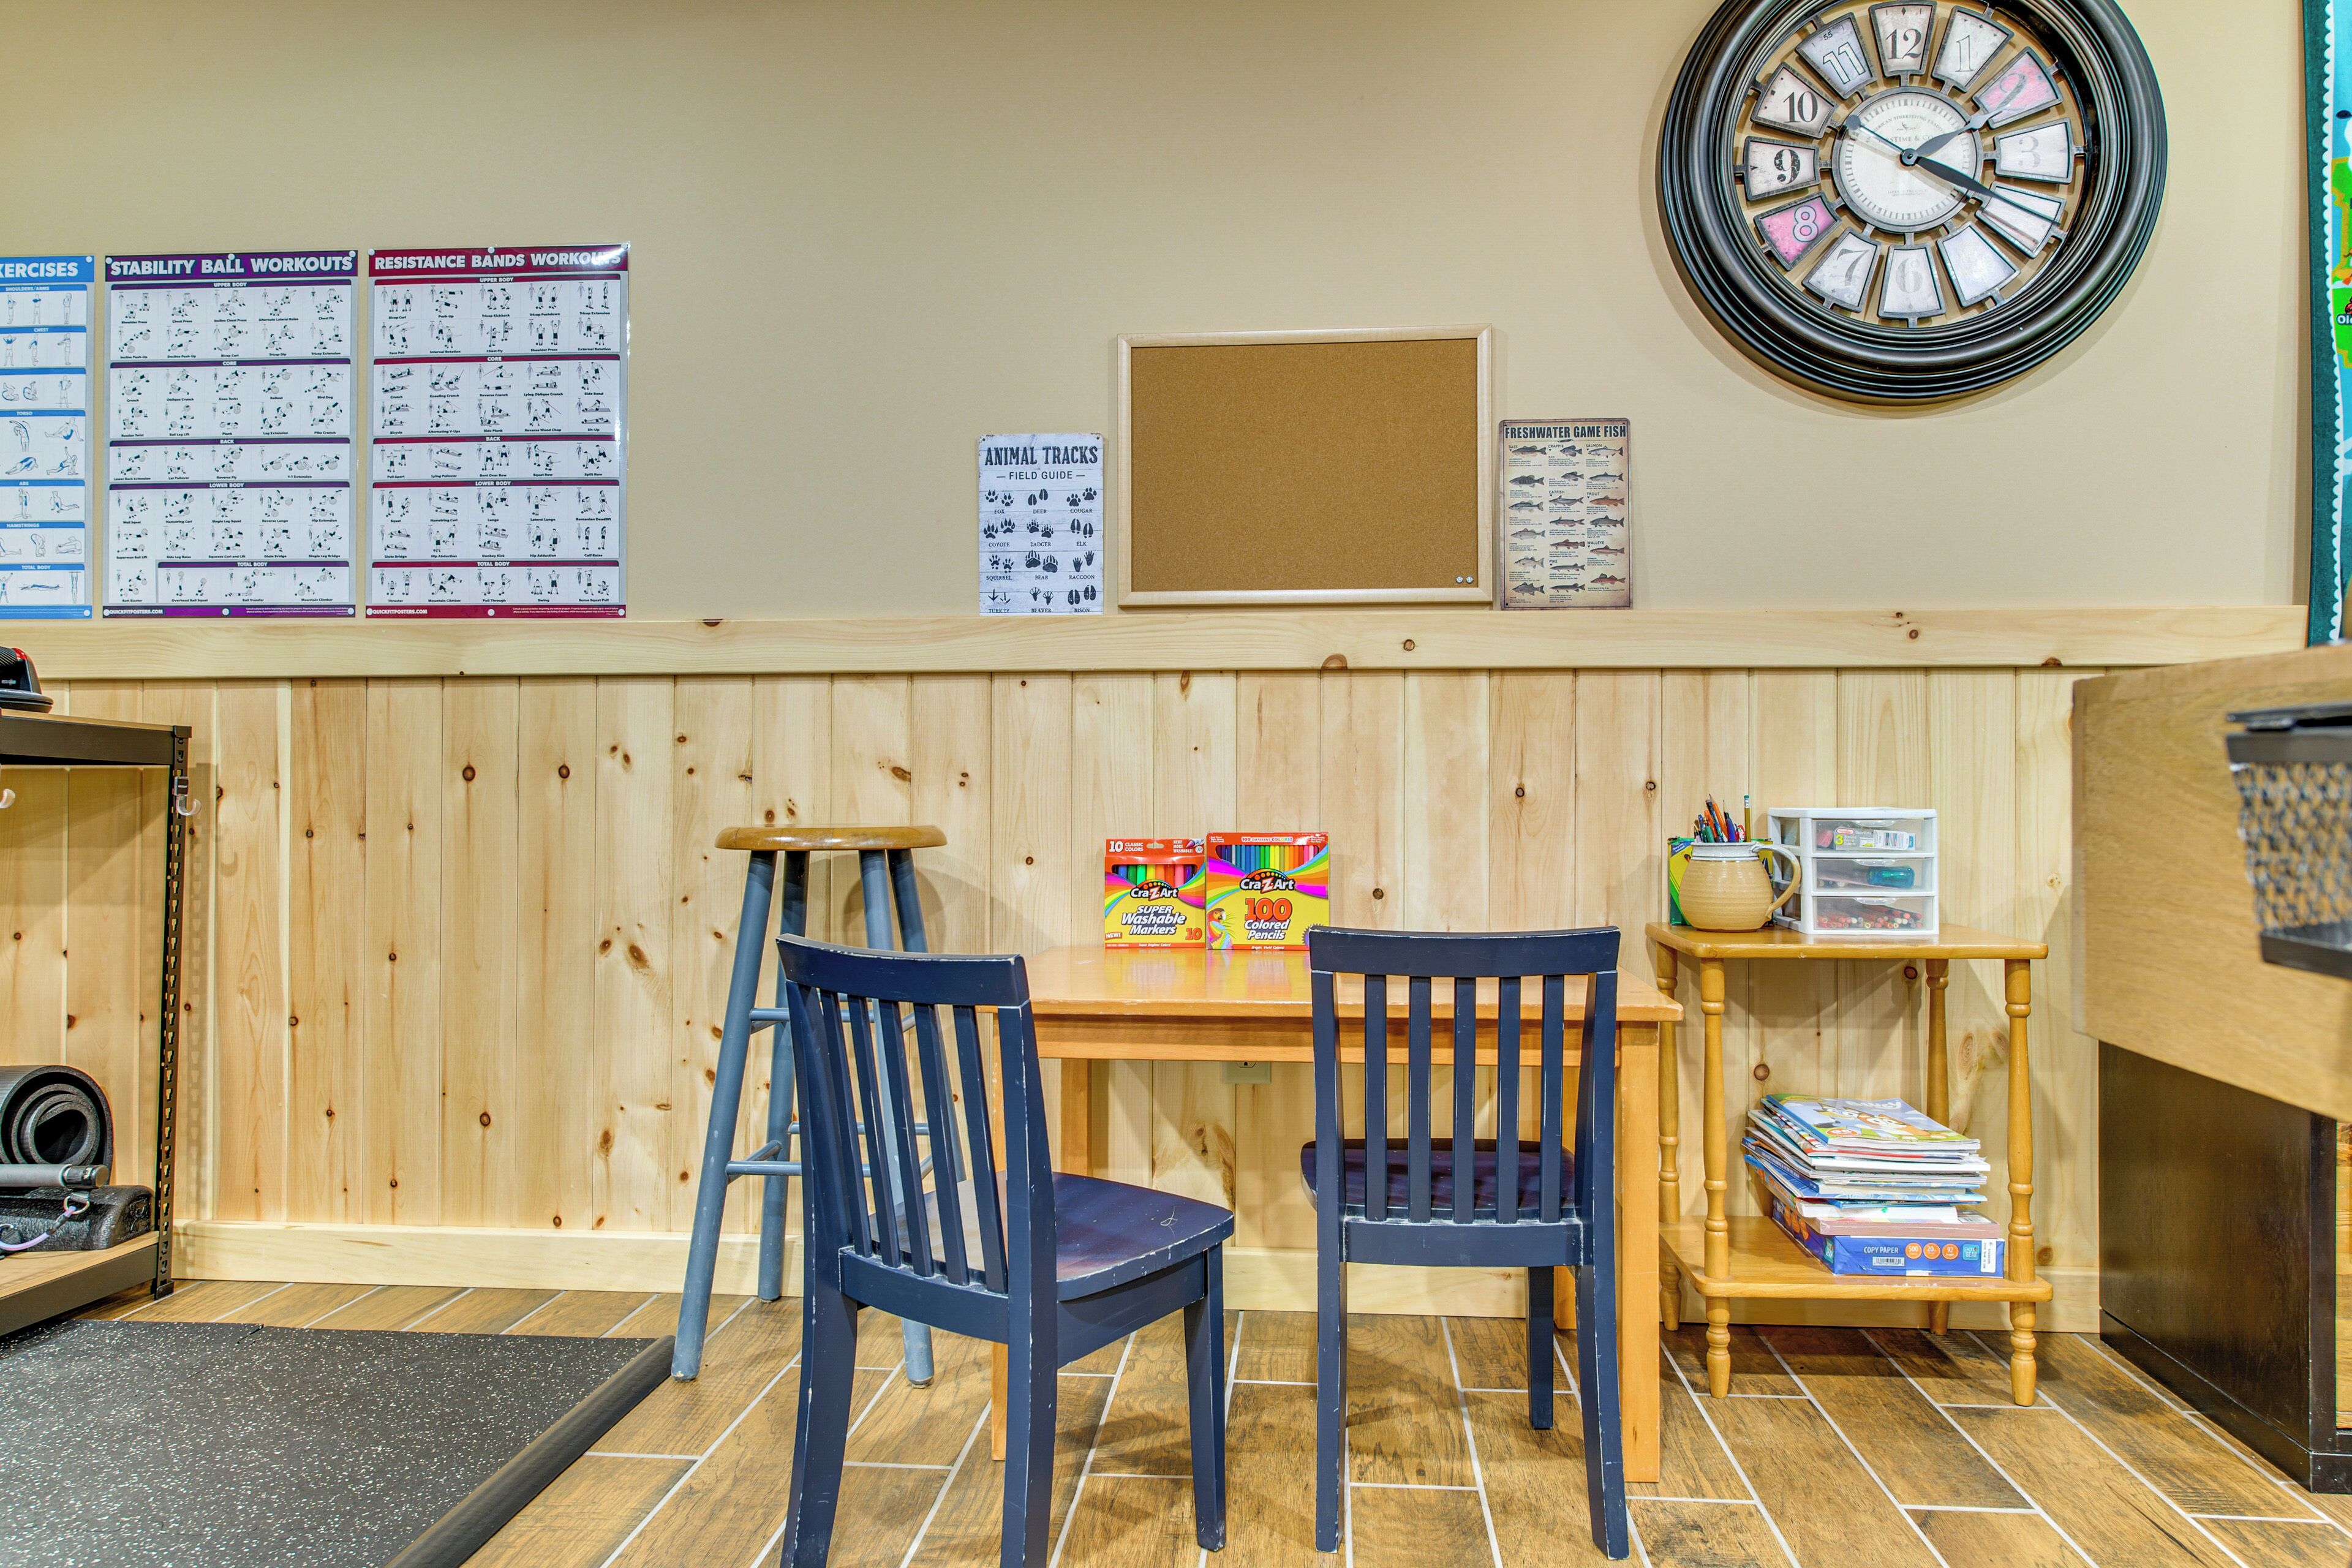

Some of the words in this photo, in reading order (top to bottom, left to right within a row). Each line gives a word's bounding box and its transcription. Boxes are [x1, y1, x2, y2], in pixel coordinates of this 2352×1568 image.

[1823, 31, 1833, 40] 55
[1886, 28, 1921, 59] 12
[1956, 35, 1973, 72] 1
[1822, 42, 1866, 84] 11
[1996, 73, 2027, 111] 2
[1782, 91, 1818, 123] 10
[2018, 136, 2039, 168] 3
[1774, 149, 1801, 184] 9
[1793, 205, 1819, 243] 8
[111, 260, 195, 277] STABILITY
[201, 259, 245, 274] BALL
[251, 257, 353, 273] WORKOUTS
[375, 255, 466, 270] RESISTANCE
[472, 254, 525, 268] BANDS
[1837, 249, 1869, 286] 7
[1896, 258, 1924, 293] 6
[1505, 426, 1570, 439] FRESHWATER
[1574, 426, 1600, 438] GAME
[1604, 426, 1626, 437] FISH
[985, 446, 1038, 466] ANIMAL
[1043, 446, 1098, 466] TRACKS
[1009, 472, 1038, 480] FIELD
[1041, 471, 1073, 480] GUIDE
[1109, 841, 1124, 852] 10
[1836, 835, 1844, 845] 3
[1131, 886, 1178, 900] Cra-Z-Art
[1240, 877, 1294, 894] Cra-Z-Art
[1121, 913, 1186, 924] Washable
[1245, 898, 1292, 921] 100
[1129, 925, 1176, 935] Markers
[1185, 927, 1202, 940] 10
[1245, 919, 1290, 930] Colored
[1247, 930, 1285, 940] Pencils
